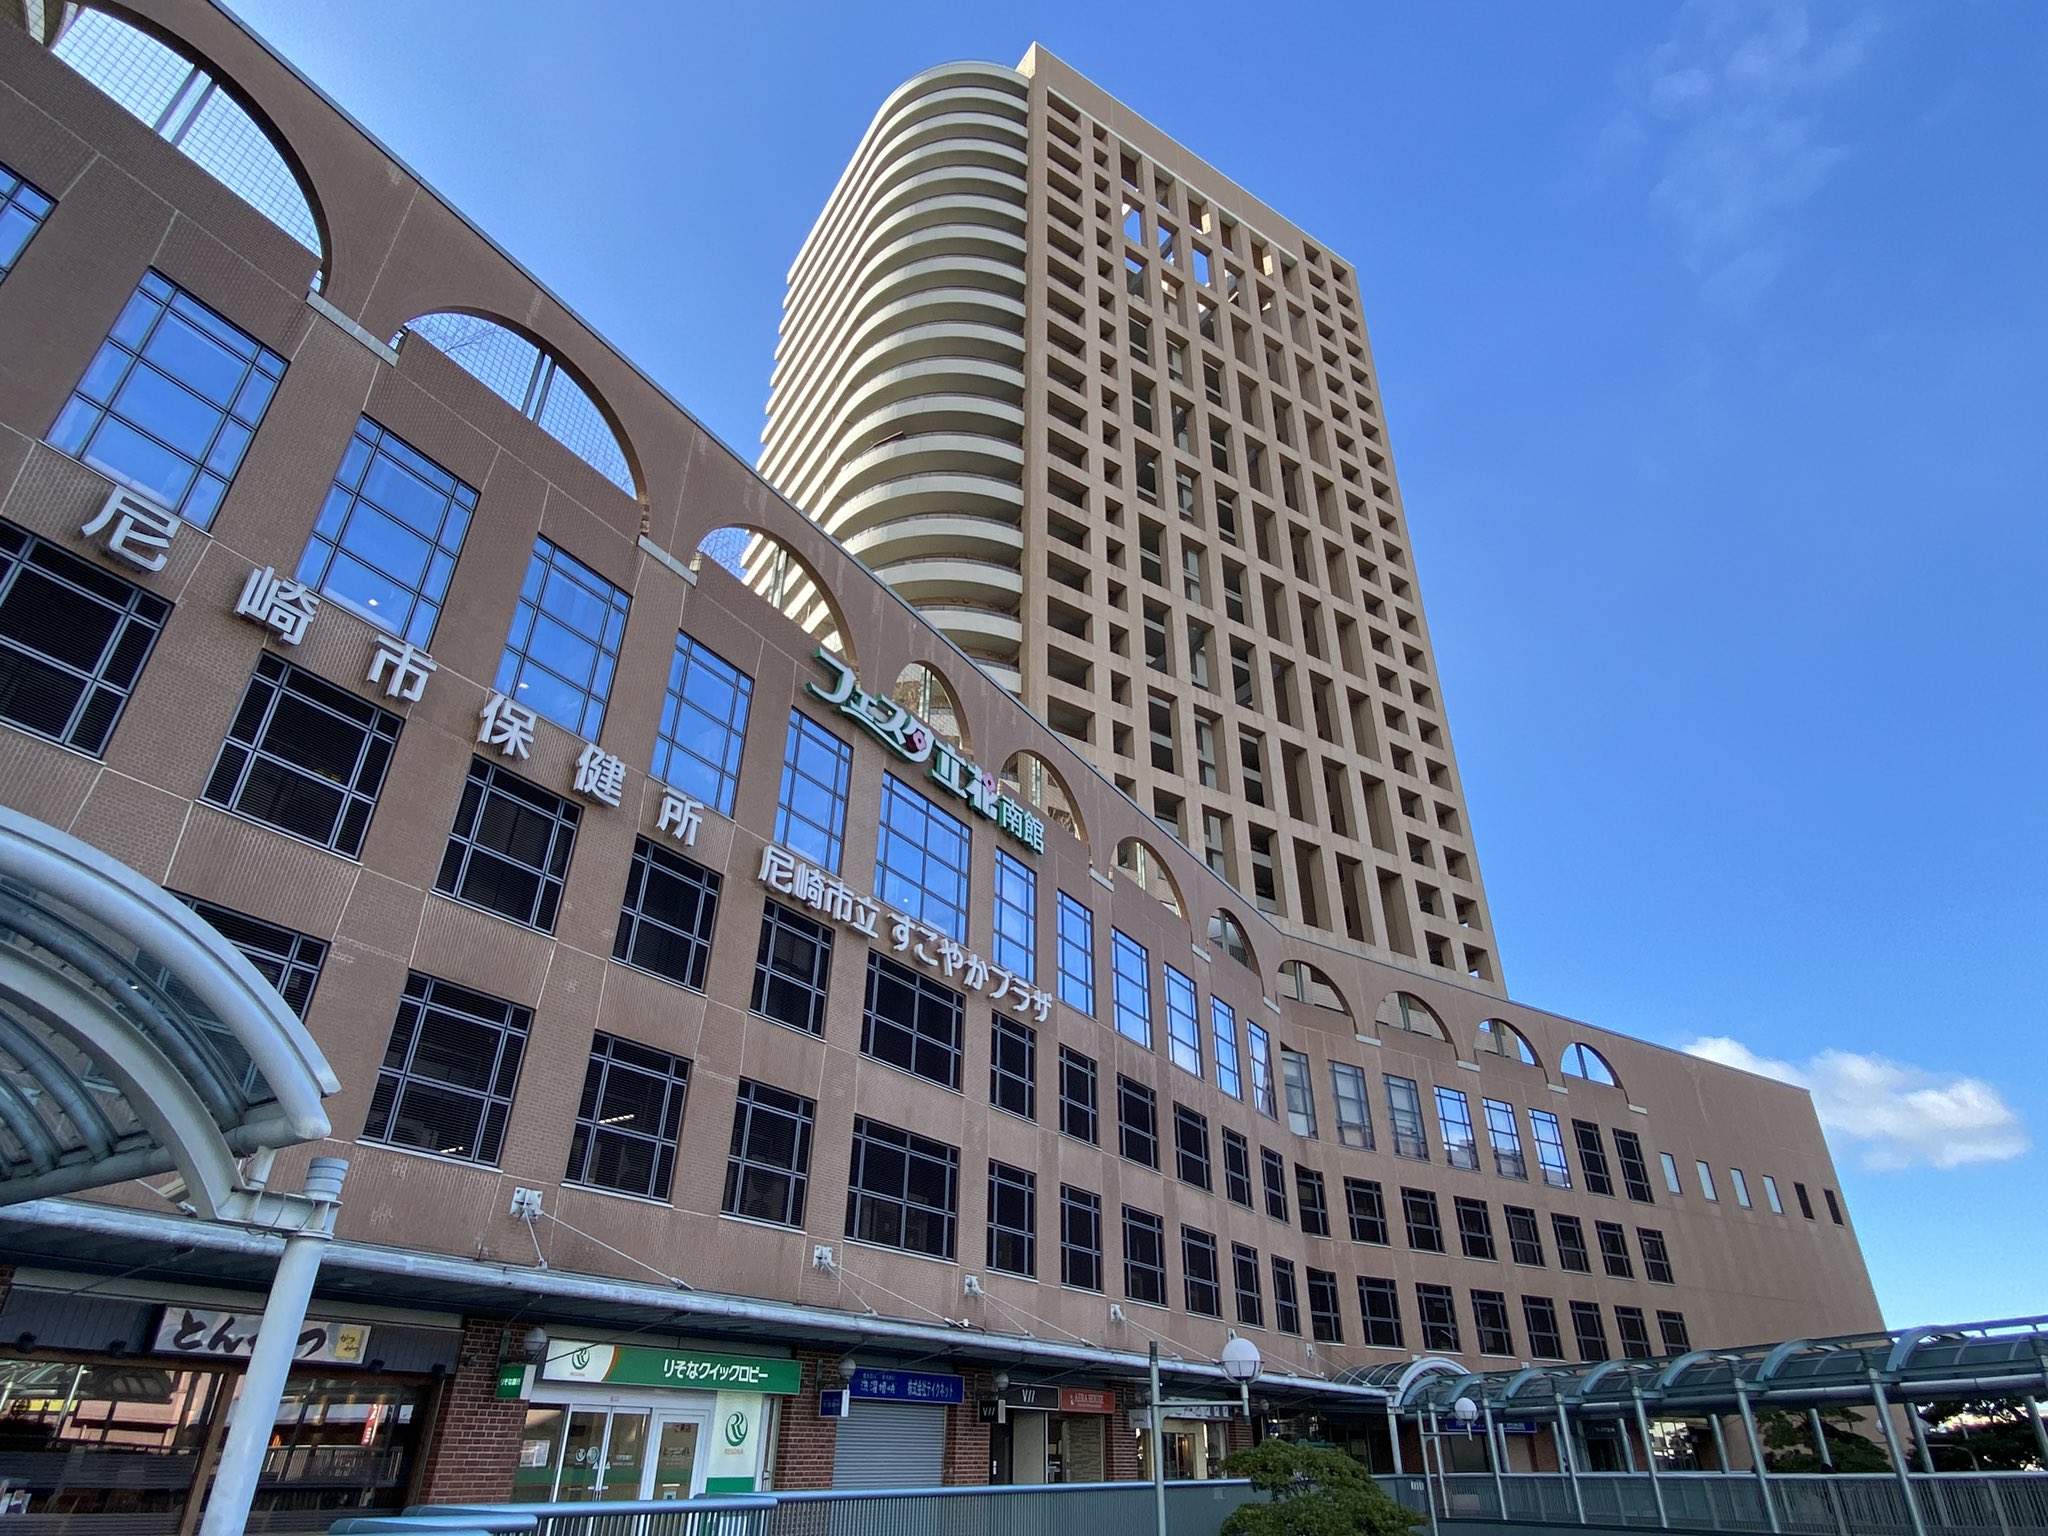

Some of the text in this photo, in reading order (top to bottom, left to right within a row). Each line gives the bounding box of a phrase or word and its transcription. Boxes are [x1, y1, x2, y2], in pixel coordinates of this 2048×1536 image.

[81, 485, 704, 846] 尼崎市保健所
[758, 845, 1053, 1022] 尼崎市立 すこやかプラザ
[173, 1310, 327, 1358] とんつ
[664, 1358, 769, 1383] りそなクイックロビー
